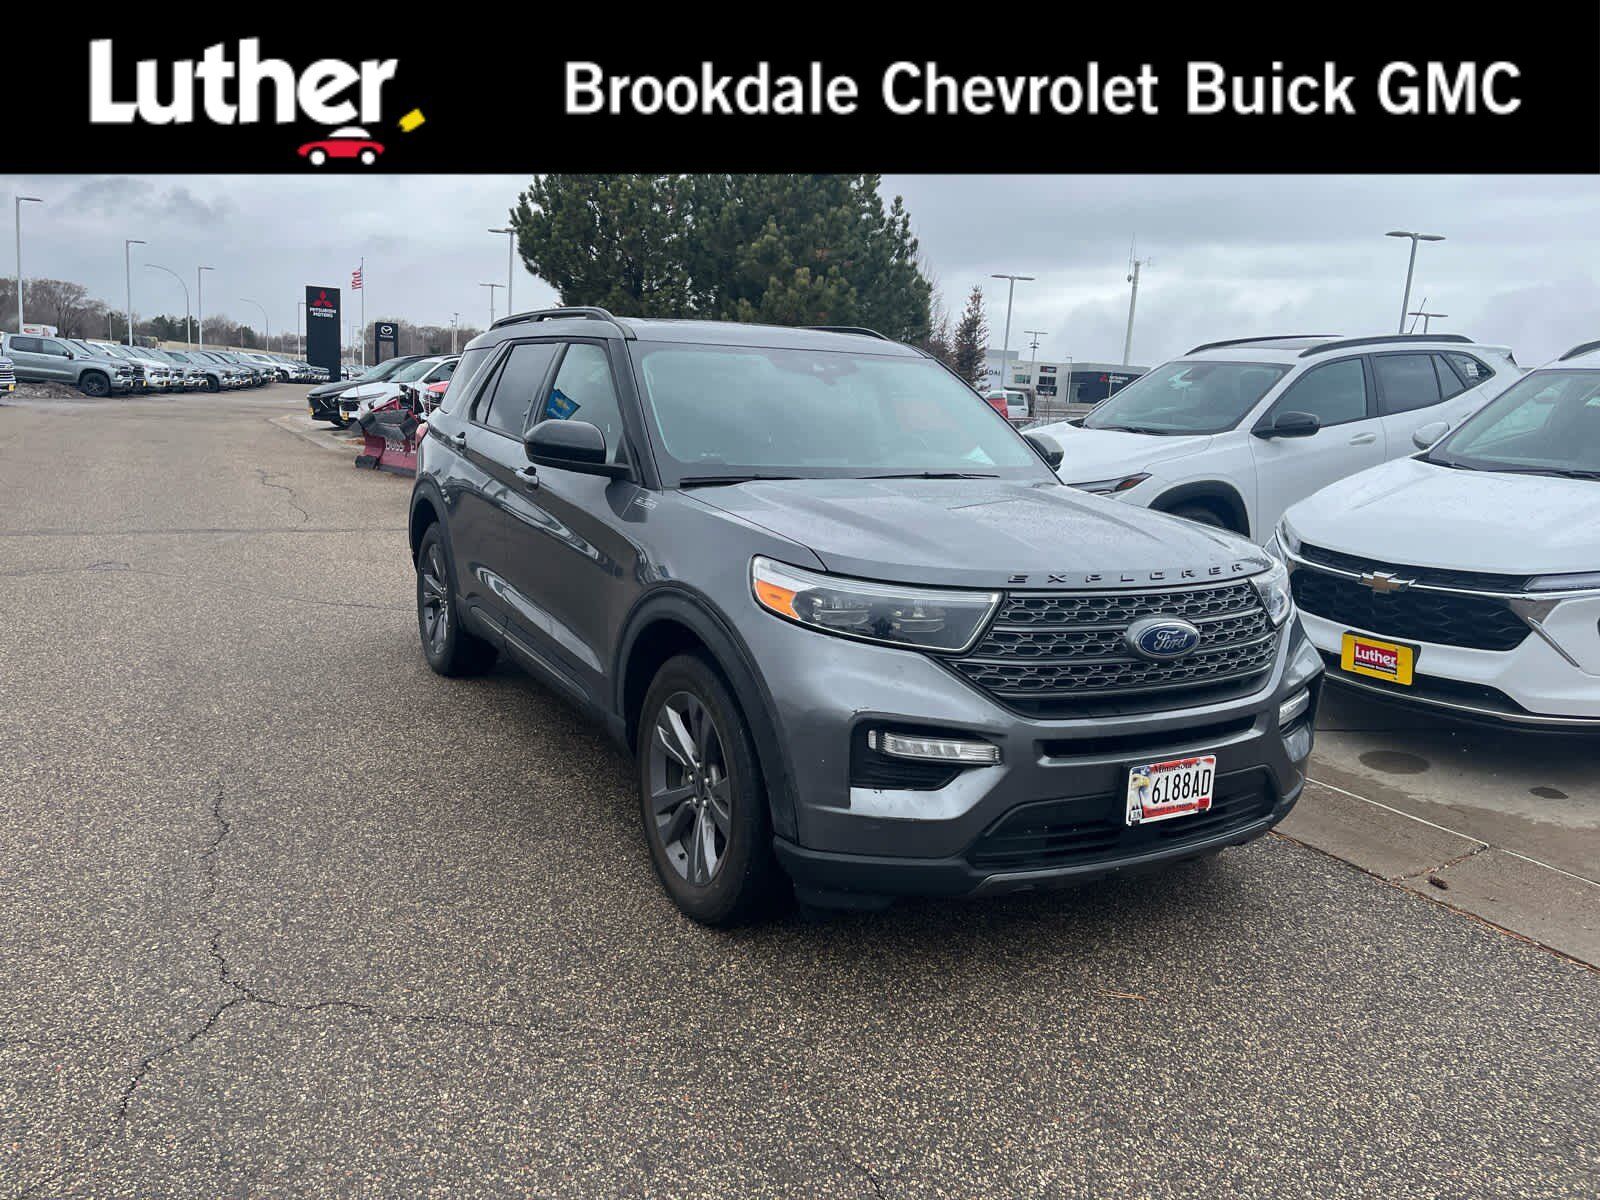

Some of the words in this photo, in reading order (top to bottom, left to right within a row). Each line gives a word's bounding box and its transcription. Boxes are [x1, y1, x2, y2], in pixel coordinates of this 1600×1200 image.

[1007, 563, 1244, 583] EXPLORER
[1153, 630, 1188, 650] Ford
[1355, 645, 1397, 664] Luther
[1151, 769, 1212, 804] 6188AD
